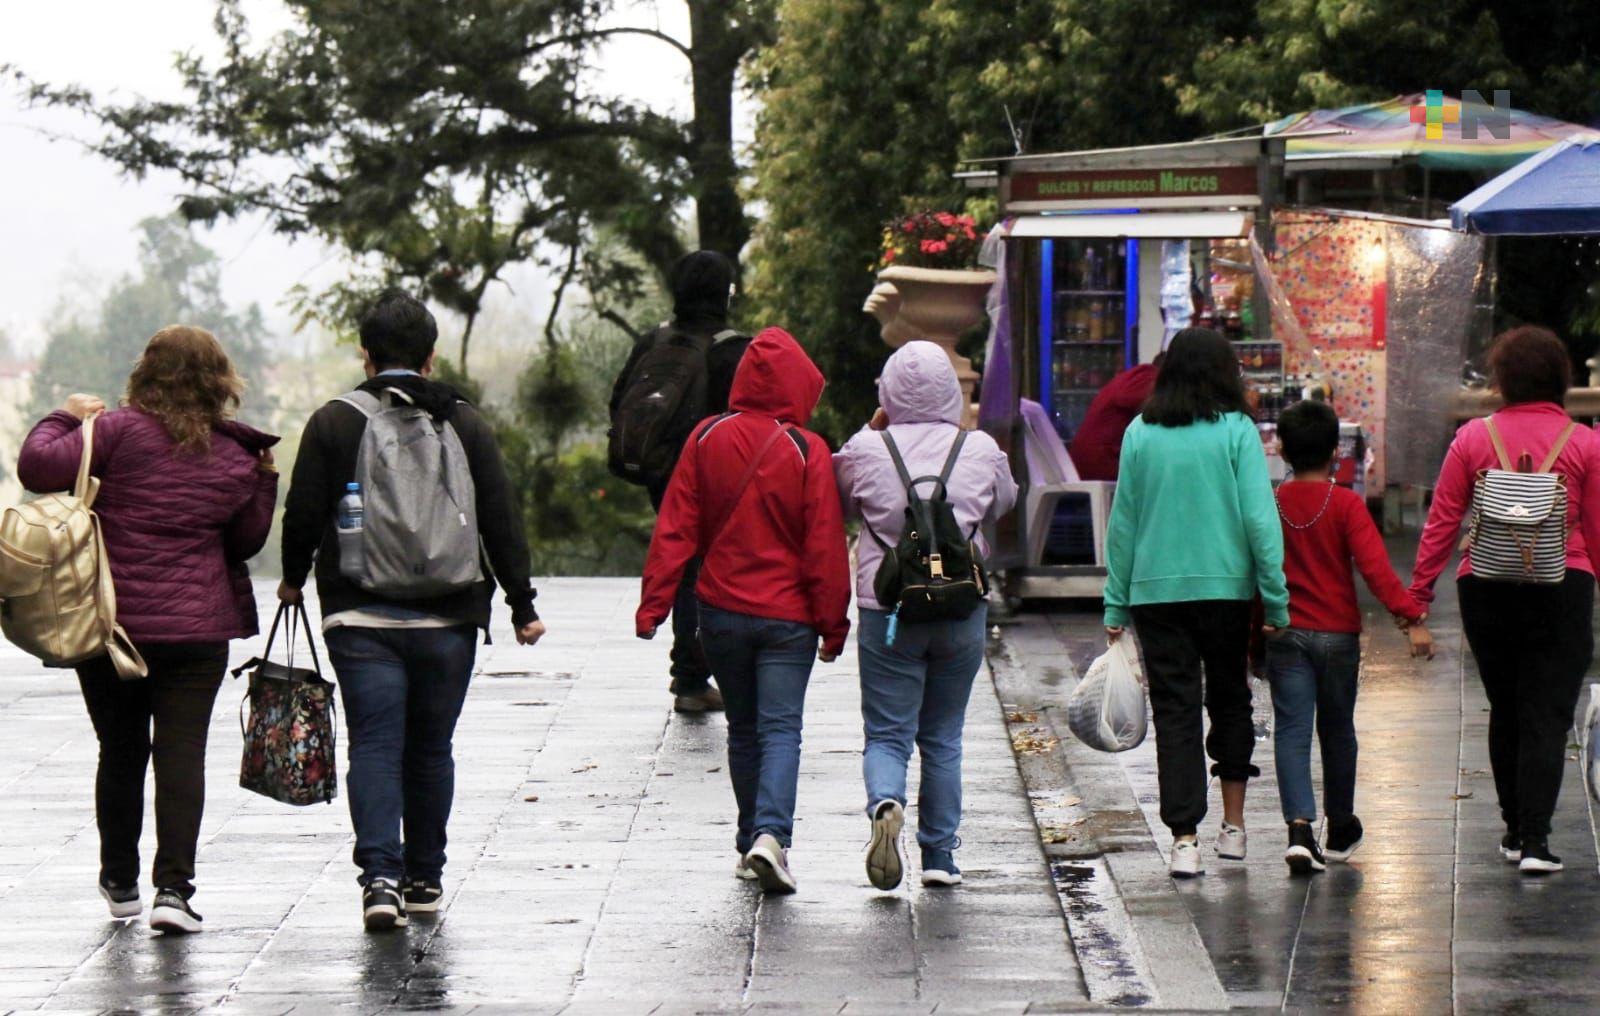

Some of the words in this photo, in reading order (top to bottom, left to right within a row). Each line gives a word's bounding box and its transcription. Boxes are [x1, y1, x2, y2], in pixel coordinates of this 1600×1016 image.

[1039, 181, 1081, 194] DULCES
[1083, 181, 1090, 193] Y
[1092, 180, 1156, 192] REFRESCOS
[1160, 172, 1218, 191] Marcos
